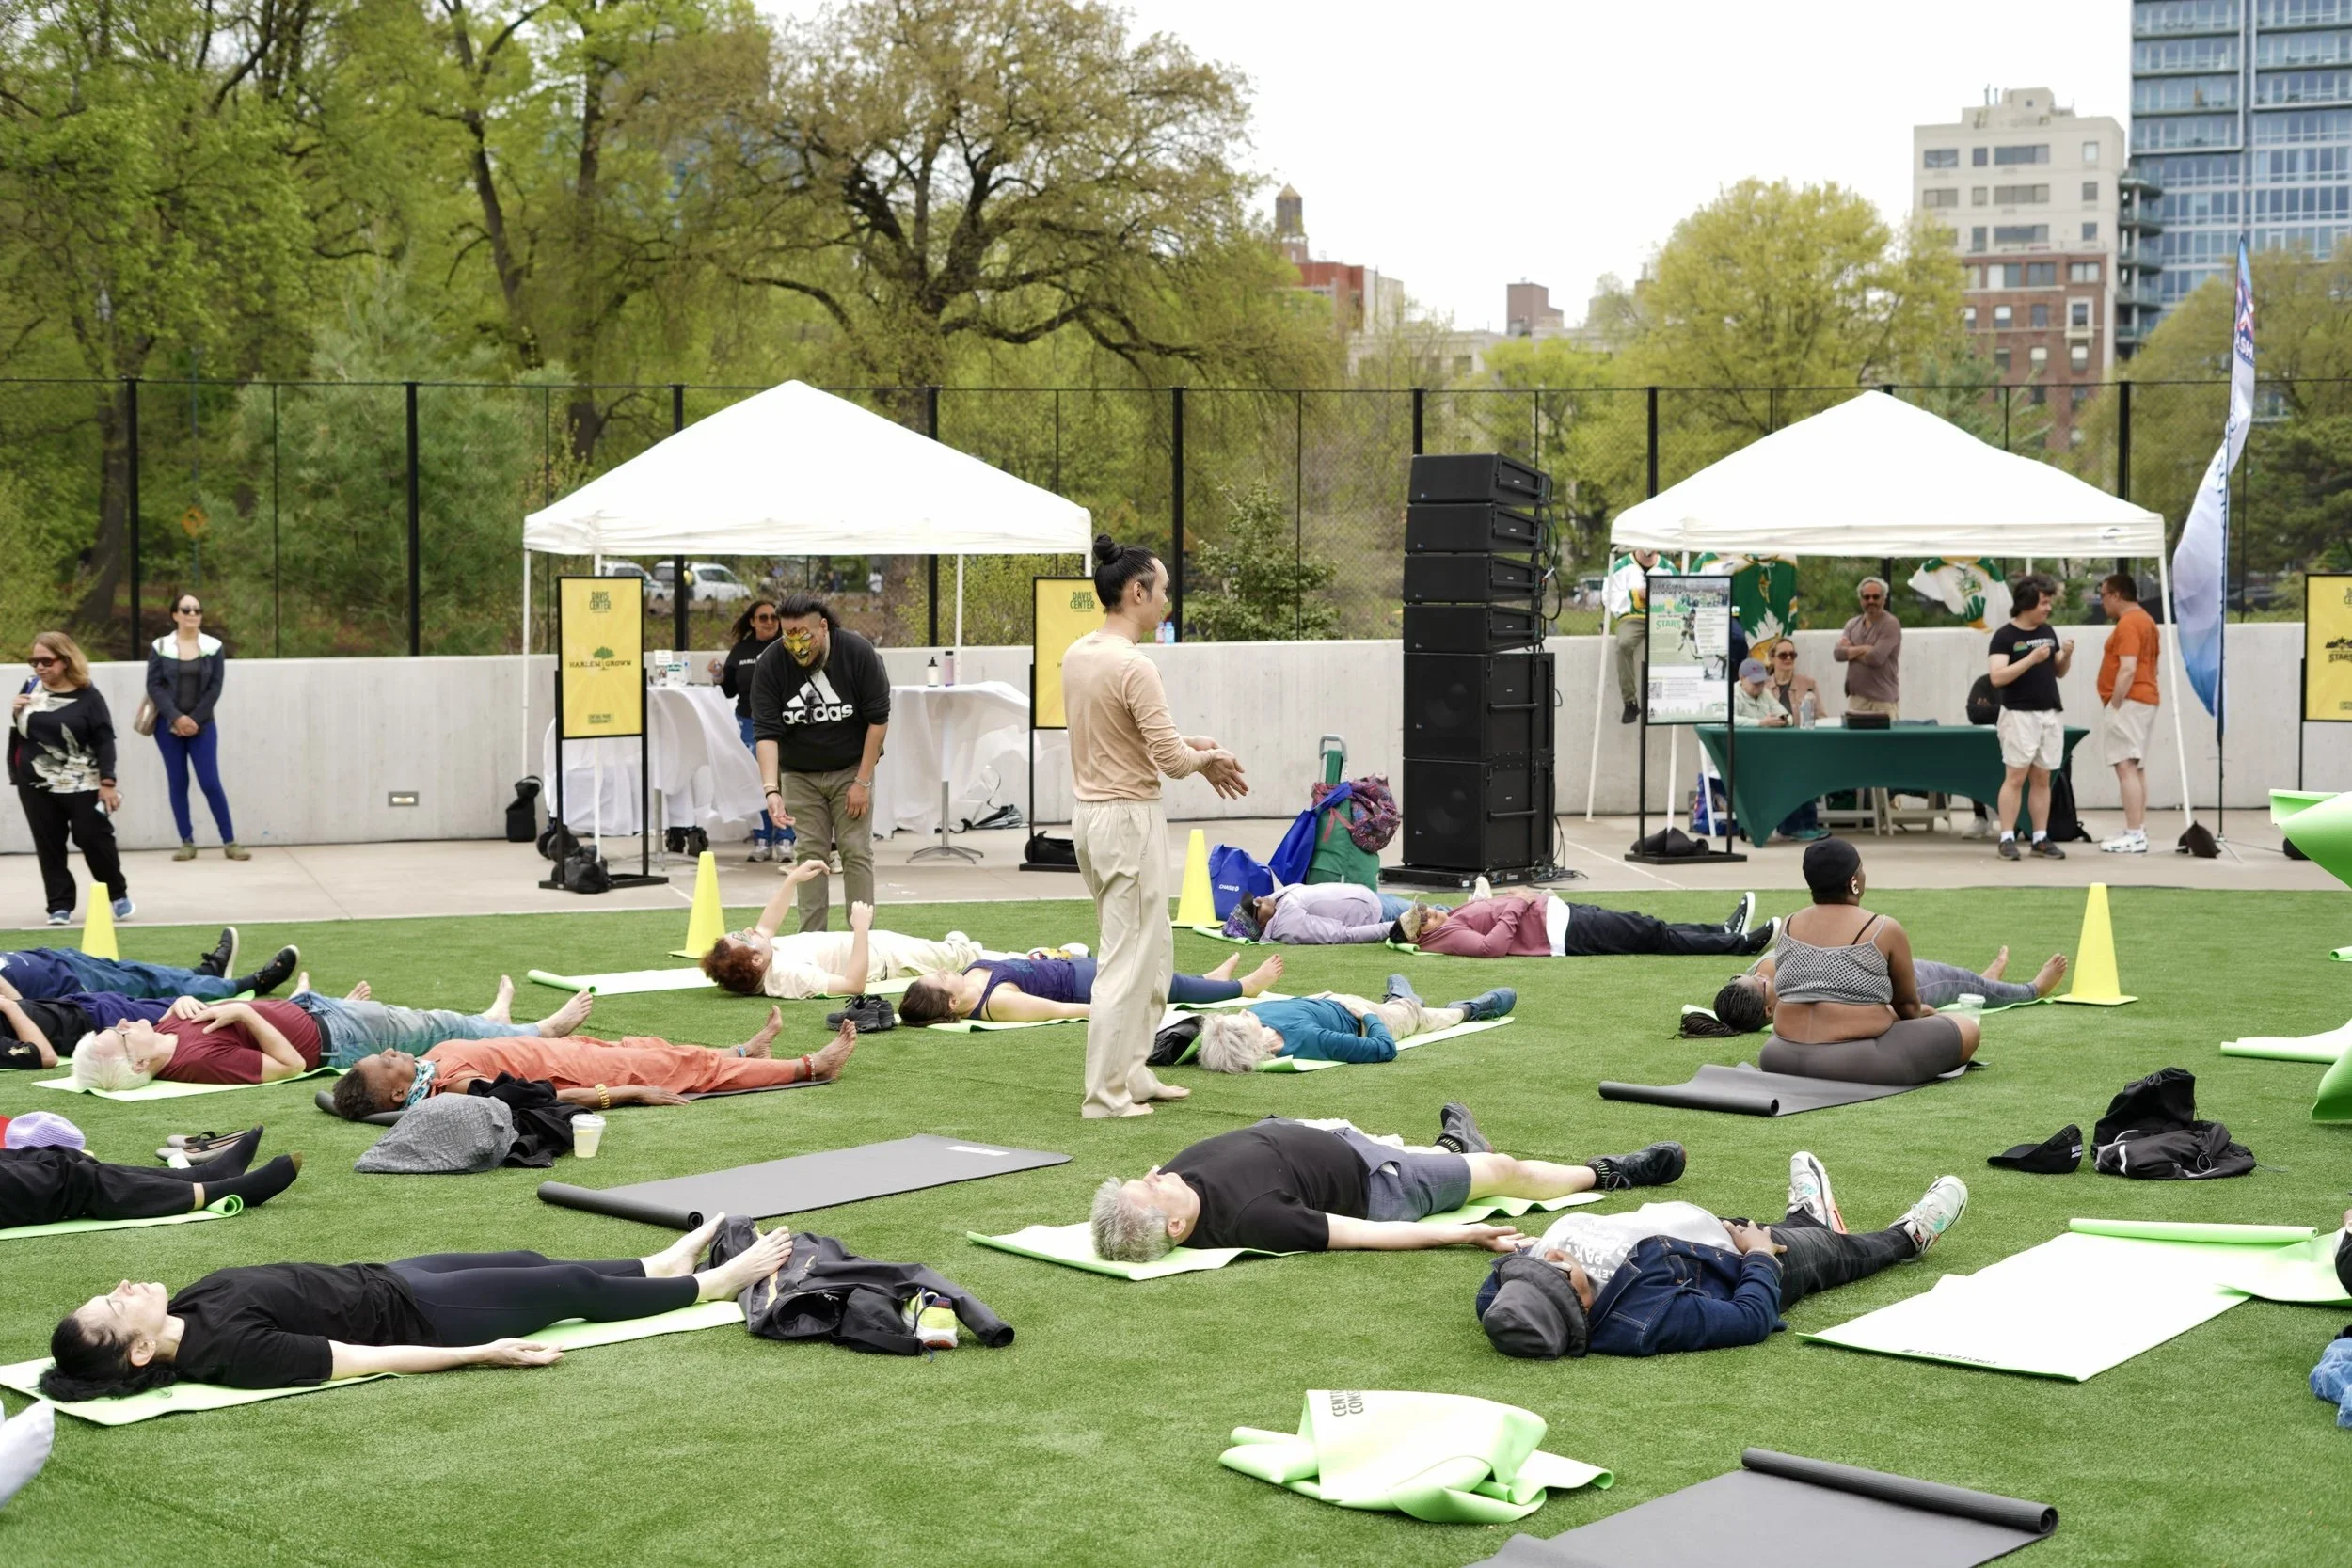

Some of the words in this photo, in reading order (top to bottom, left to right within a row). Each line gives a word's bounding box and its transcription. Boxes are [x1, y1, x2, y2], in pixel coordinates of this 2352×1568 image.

[591, 591, 609, 601] DAVIS
[1073, 592, 1091, 601] DAVIS
[589, 600, 612, 610] CENTER
[1070, 600, 1094, 609] CENTER
[1656, 620, 1681, 630] STARS
[782, 703, 854, 725] addas
